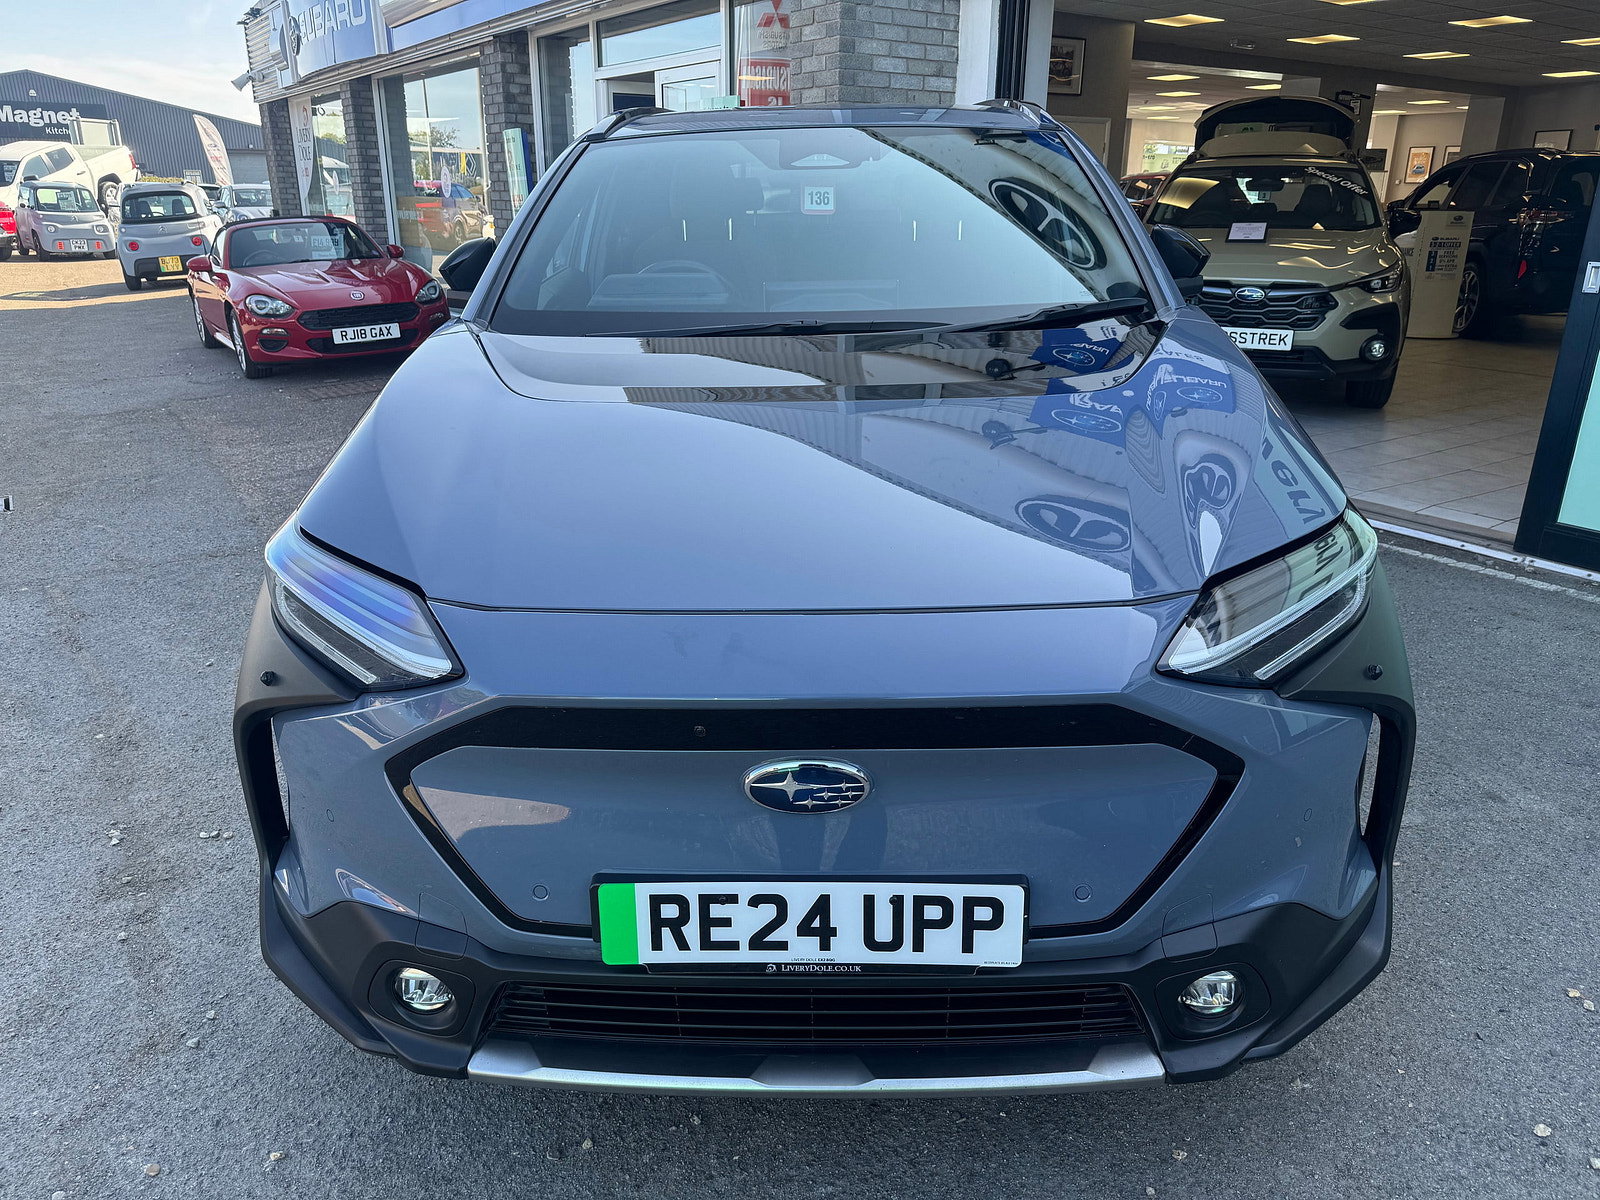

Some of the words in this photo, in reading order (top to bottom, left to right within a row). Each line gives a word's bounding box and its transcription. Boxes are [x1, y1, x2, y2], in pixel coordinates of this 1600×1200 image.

[0, 105, 80, 127] Magnet
[45, 126, 71, 135] Kitch
[1304, 166, 1343, 182] Special
[1340, 180, 1368, 195] Offer
[808, 191, 830, 205] 136
[340, 328, 367, 341] RJ18
[370, 326, 393, 338] GAX
[1226, 331, 1289, 346] SSTREK
[648, 893, 838, 952] RE24
[862, 893, 1006, 954] UPP
